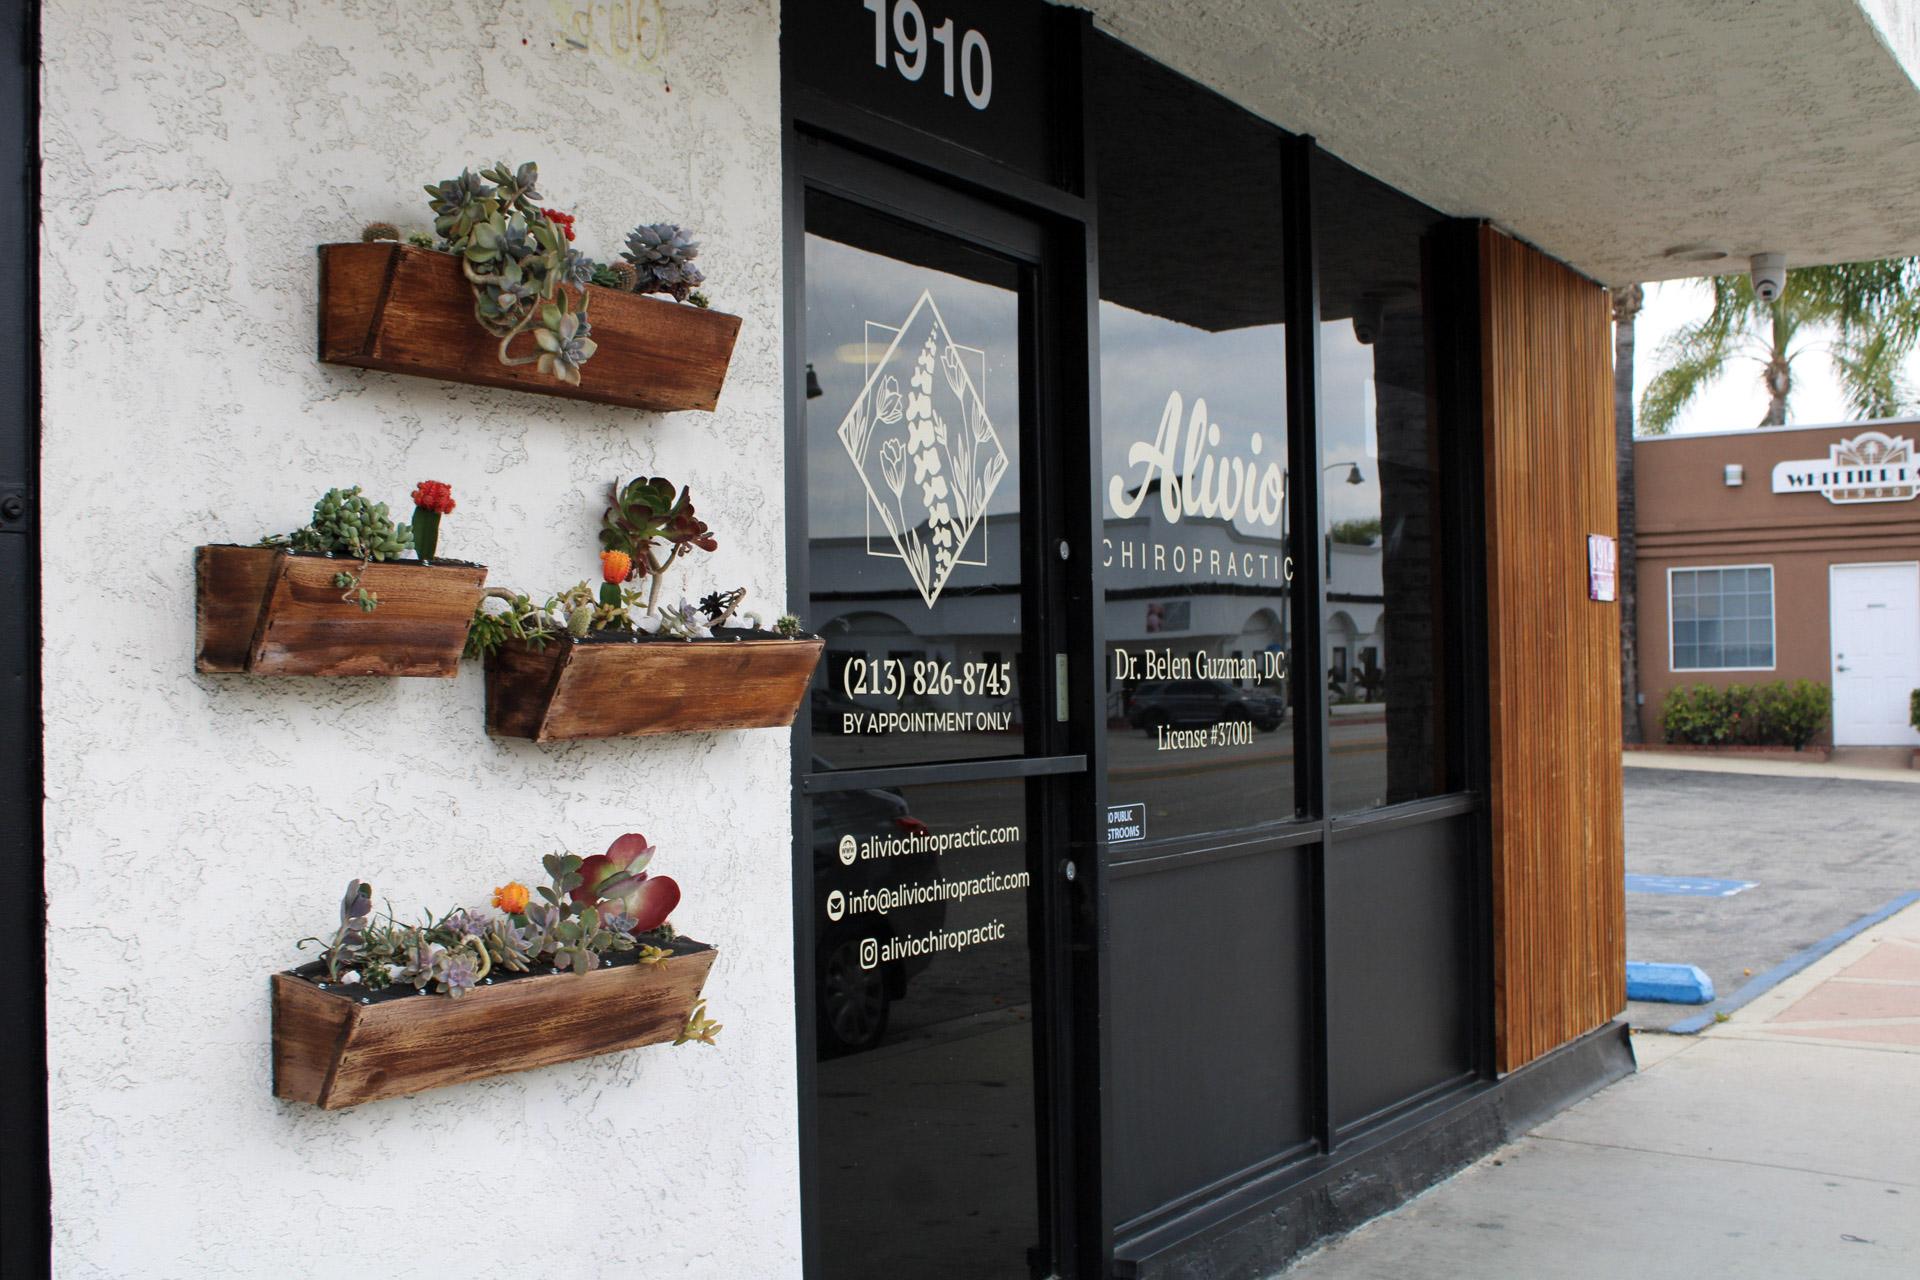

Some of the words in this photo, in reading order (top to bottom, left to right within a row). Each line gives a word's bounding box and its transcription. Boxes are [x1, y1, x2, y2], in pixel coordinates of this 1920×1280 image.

[863, 0, 993, 110] 1910
[1109, 390, 1285, 526] Alivio
[1103, 538, 1294, 581] CHIROPRACTIC
[843, 657, 906, 700] (213)
[913, 660, 1011, 696] 826-8745
[1115, 648, 1141, 680] Dr.
[1145, 648, 1192, 680] Belen
[1196, 650, 1263, 685] Guzman,
[1264, 651, 1286, 679] DC
[843, 713, 865, 734] BY
[867, 712, 974, 733] APPOINTMENT
[976, 712, 1012, 731] ONLY
[1158, 725, 1208, 750] License
[1210, 721, 1253, 746] #37001
[1107, 825, 1140, 840] STROOMS
[1114, 809, 1133, 823] PUBLIC
[860, 825, 1020, 860] aliviochiropractic.com
[849, 871, 1030, 914] info@aliviochiropractic.com
[881, 919, 1006, 962] aliviochiropractic
